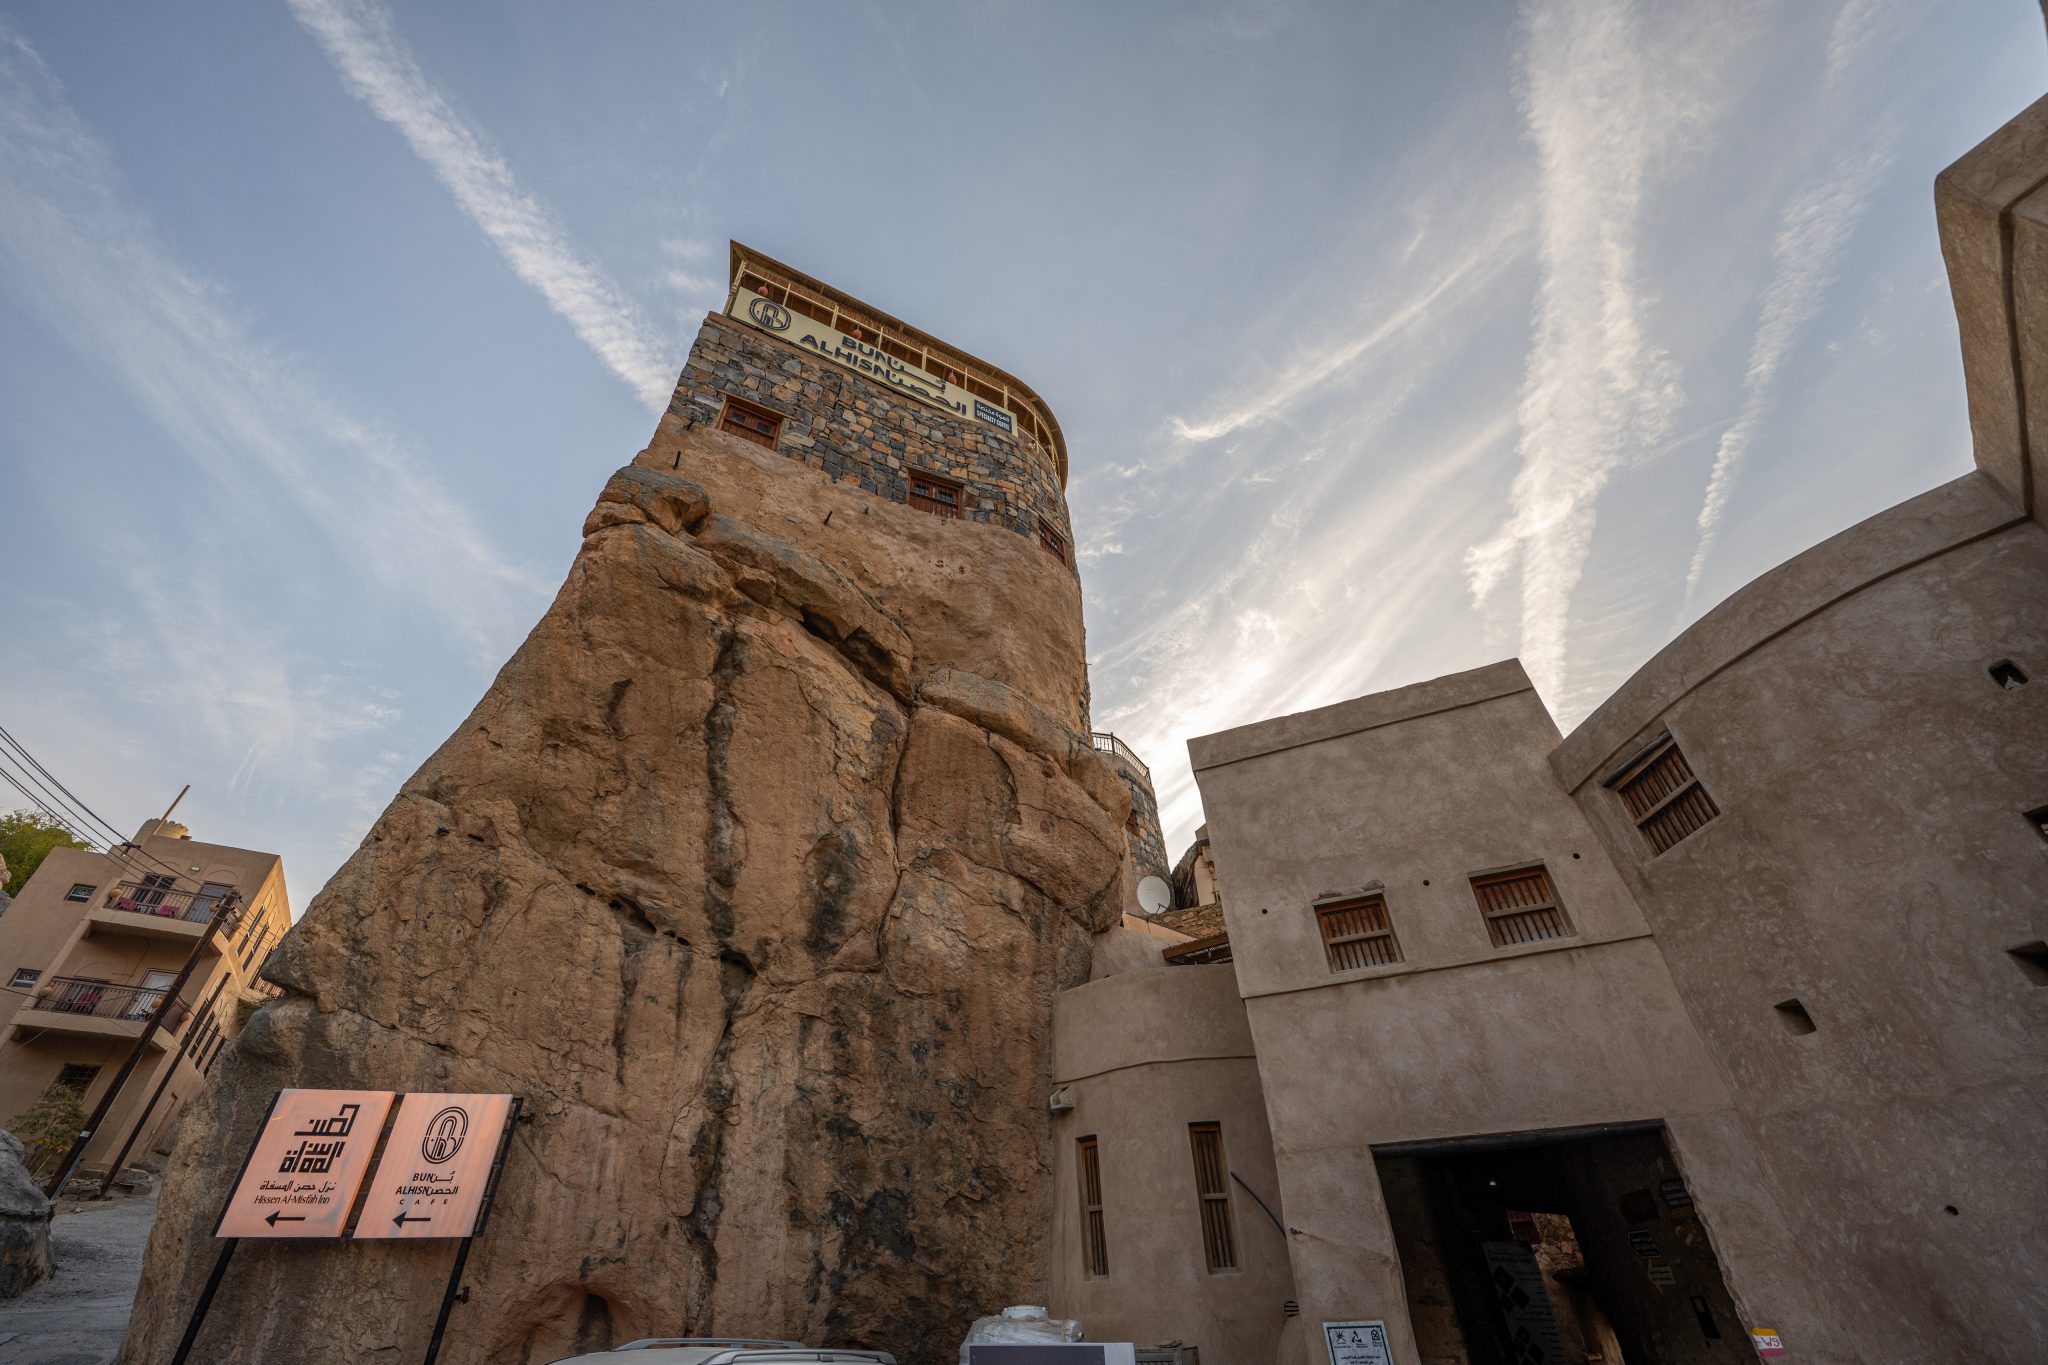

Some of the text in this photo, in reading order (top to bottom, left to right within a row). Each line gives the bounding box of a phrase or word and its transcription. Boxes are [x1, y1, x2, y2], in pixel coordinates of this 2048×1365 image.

[799, 334, 891, 381] ALHISN
[841, 335, 891, 367] BUN
[886, 370, 967, 416] الحصن
[976, 409, 996, 424] SPECIALTY
[412, 1172, 433, 1182] BUN
[259, 1180, 337, 1193] نزل حصن المسفاة
[395, 1185, 429, 1195] ALHISN
[425, 1186, 459, 1197] الحصن
[254, 1193, 330, 1205] Hissen Al-Misfah Inn
